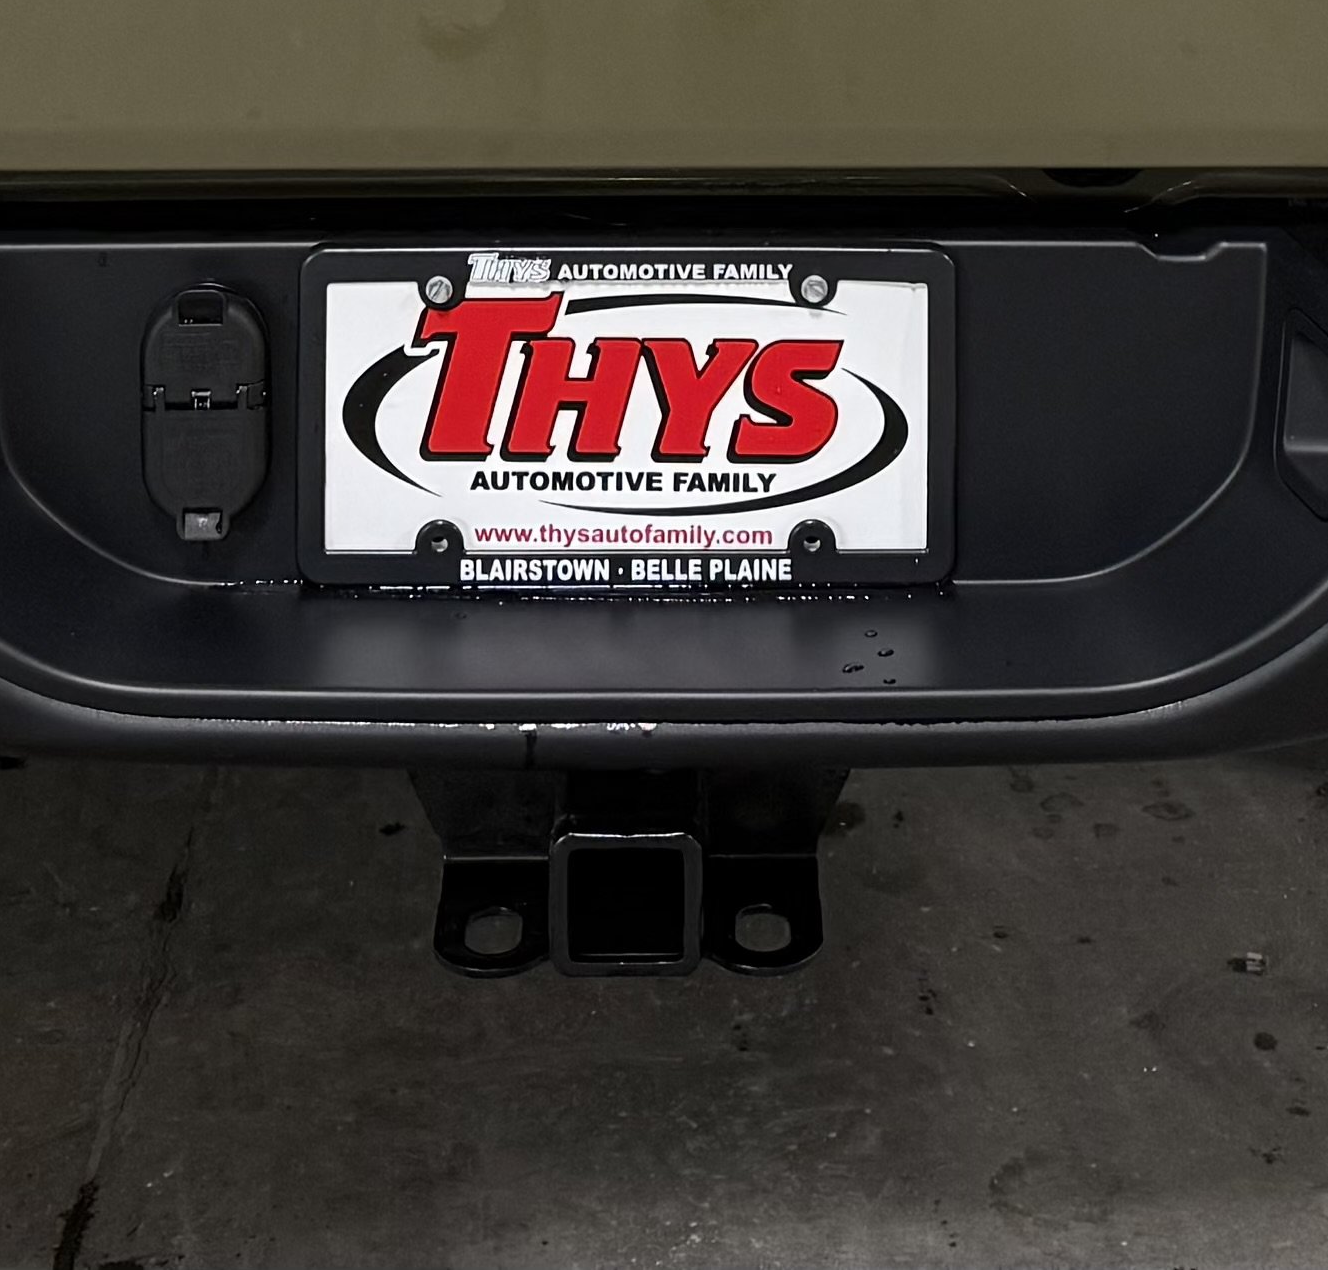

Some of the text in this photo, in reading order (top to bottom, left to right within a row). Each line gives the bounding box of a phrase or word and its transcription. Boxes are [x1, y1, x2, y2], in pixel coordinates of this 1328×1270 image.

[557, 263, 706, 280] AUTOMOTIVE
[713, 263, 793, 279] FAMILY
[410, 292, 844, 463] THYS
[470, 471, 776, 493] AUTOMOTIVE FAMILY
[475, 524, 772, 548] www.thysautofamily.com
[460, 558, 792, 581] BLAIRSTOWN BELLE PLAINE
